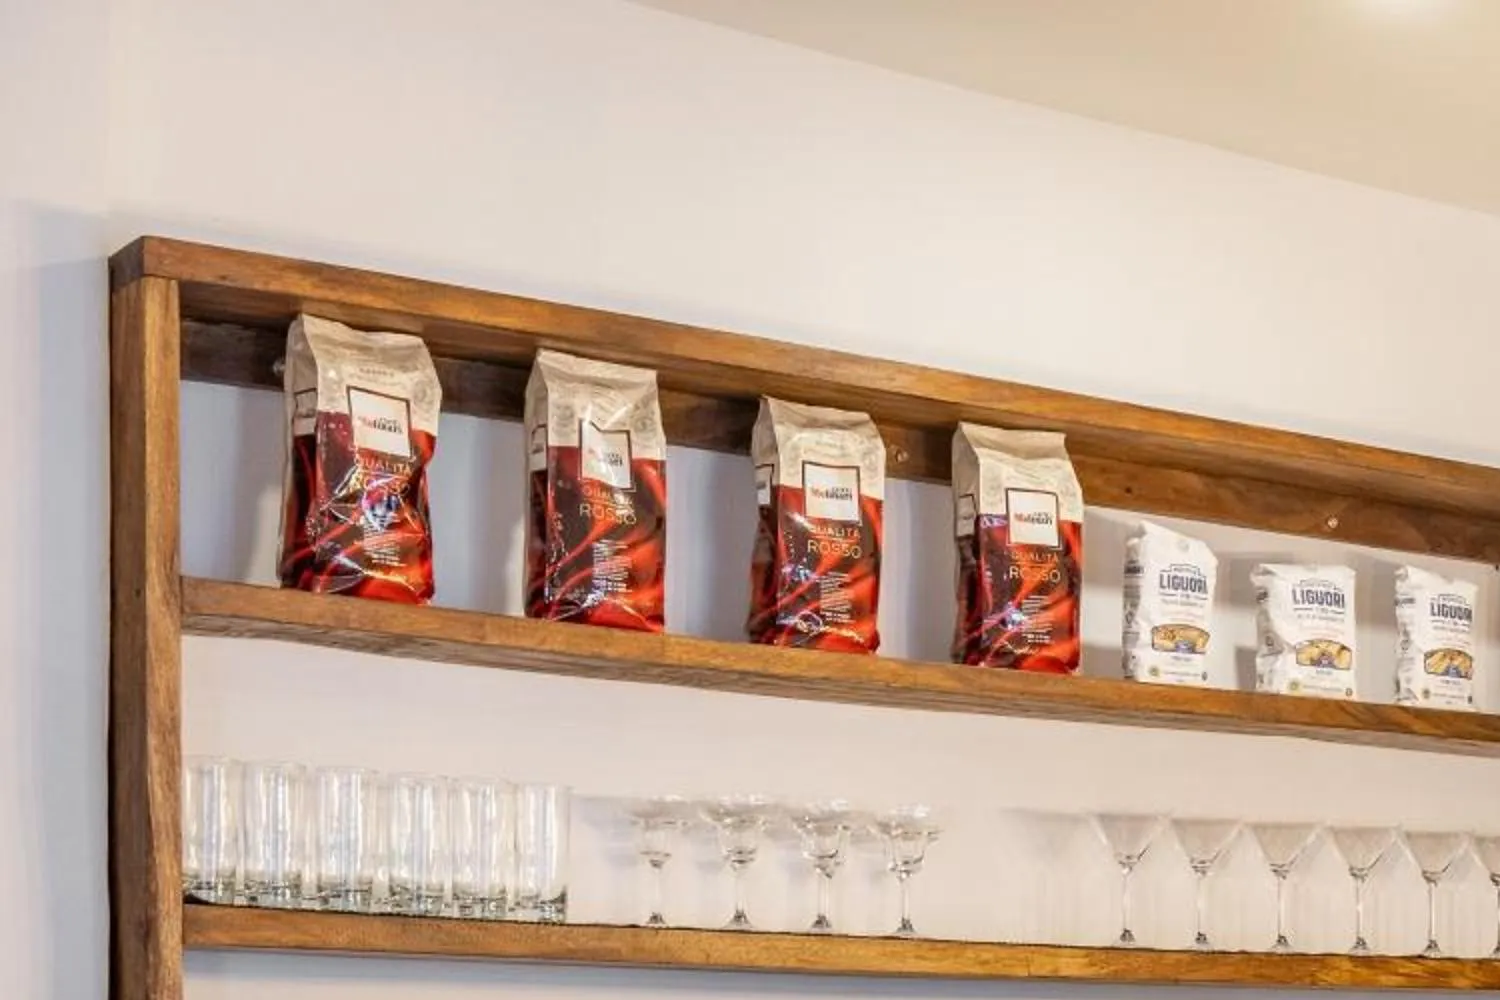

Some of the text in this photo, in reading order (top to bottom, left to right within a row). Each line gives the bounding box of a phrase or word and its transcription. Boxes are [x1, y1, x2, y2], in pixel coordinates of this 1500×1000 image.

[807, 539, 863, 560] ROSSO
[1008, 564, 1062, 583] ROSSO
[1159, 574, 1209, 595] LIGUORI
[1292, 588, 1346, 609] LIGUORI
